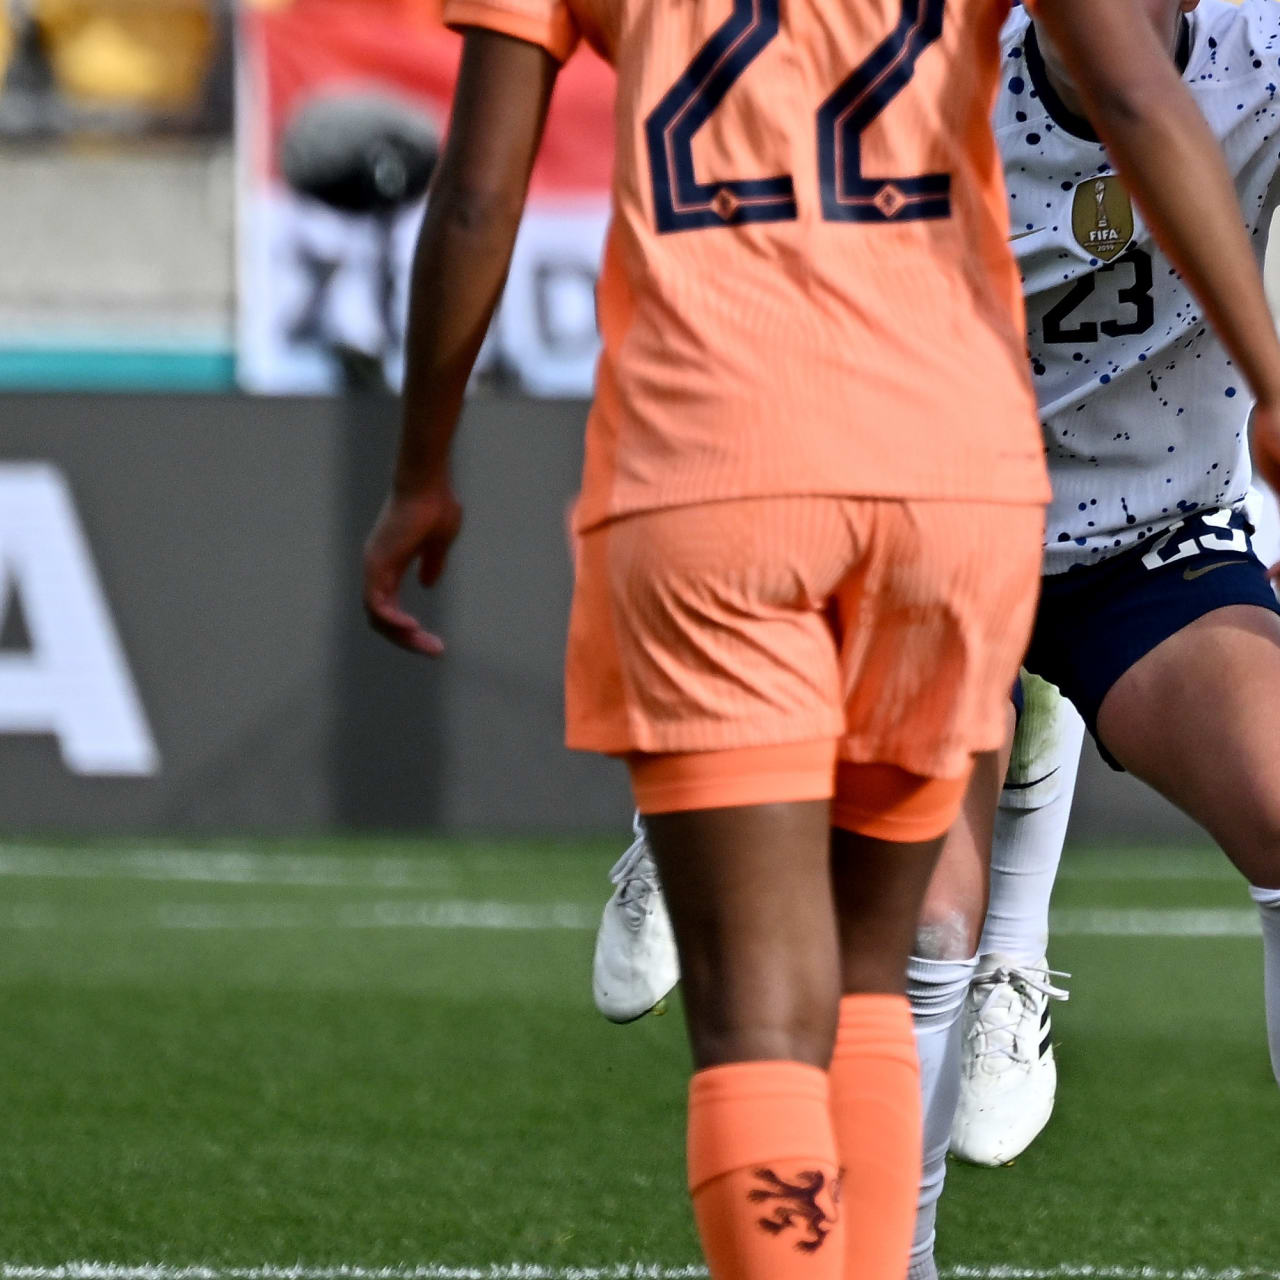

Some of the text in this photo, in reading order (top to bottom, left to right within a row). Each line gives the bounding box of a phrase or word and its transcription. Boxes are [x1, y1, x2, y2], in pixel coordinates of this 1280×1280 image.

[1089, 228, 1119, 242] FIFA
[1042, 249, 1155, 344] 23
[1141, 508, 1249, 571] 23
